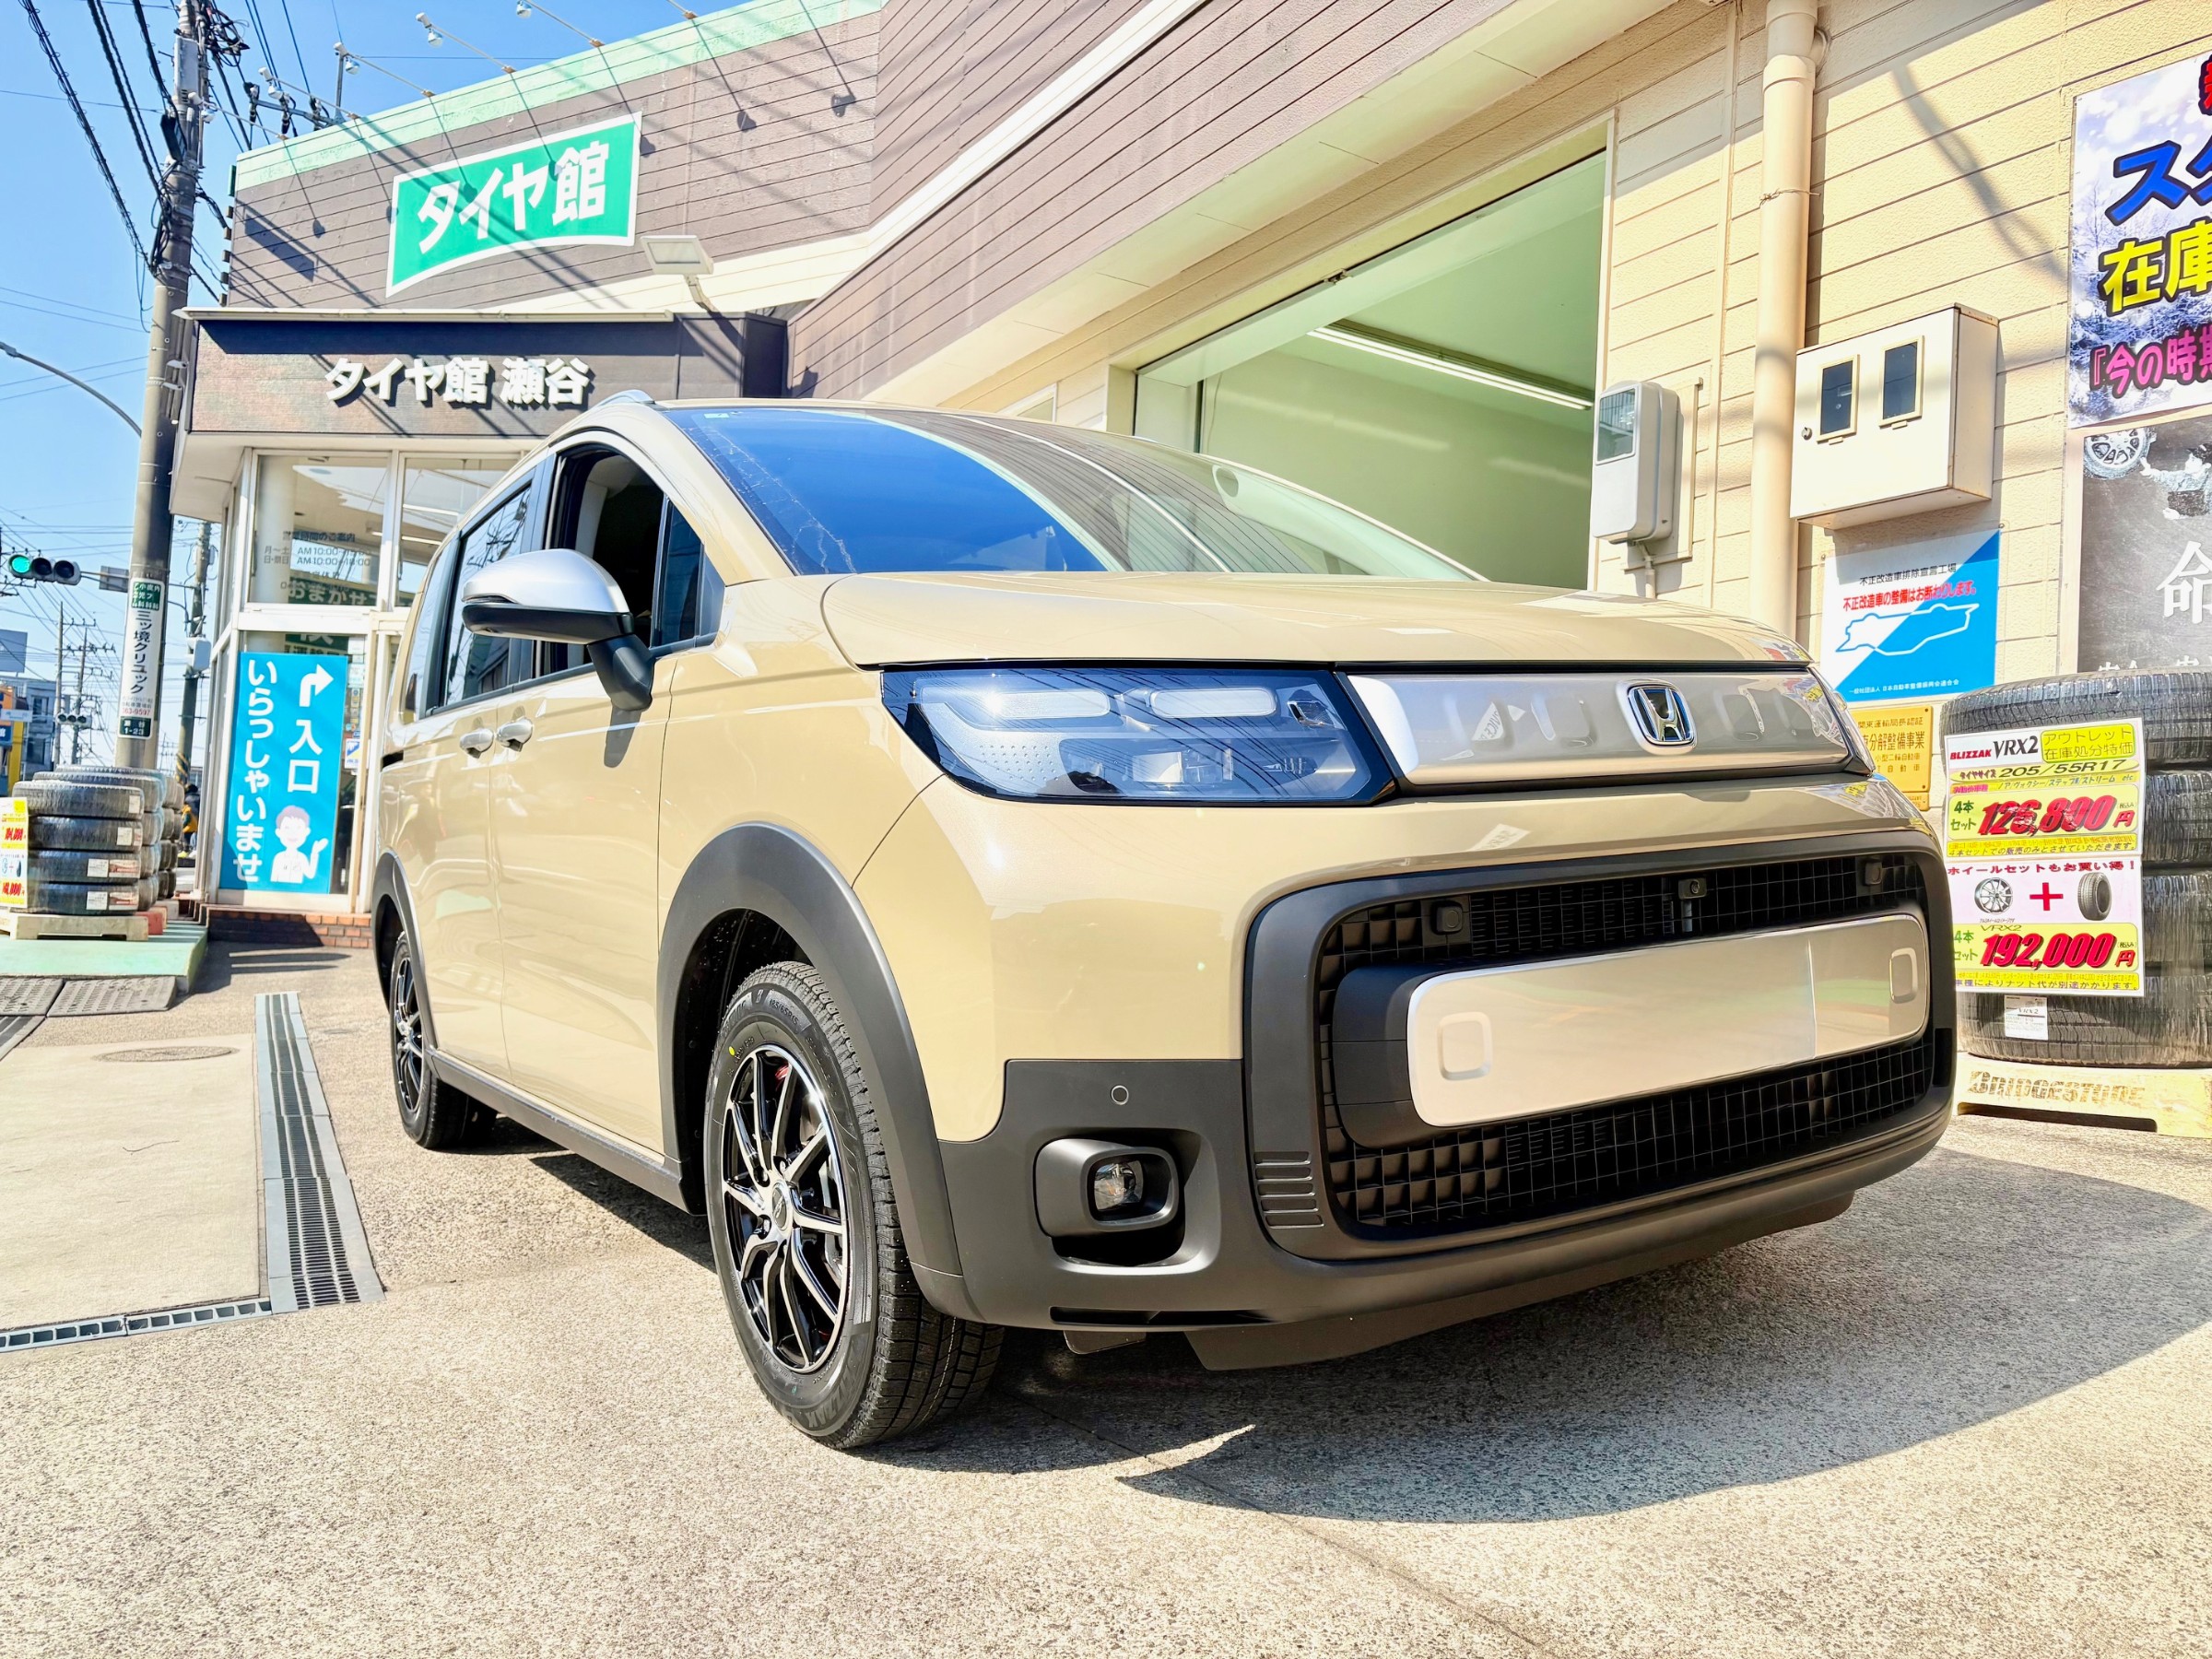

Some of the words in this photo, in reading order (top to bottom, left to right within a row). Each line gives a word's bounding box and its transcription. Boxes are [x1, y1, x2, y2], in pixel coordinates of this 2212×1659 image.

[417, 140, 609, 254] タイヤ館
[324, 357, 489, 405] タイヤ館
[500, 357, 590, 405] 瀬谷
[1859, 562, 1957, 586] 不正改造車排除宣言工場
[2156, 540, 2212, 625] 命
[1842, 581, 1977, 611] 不正改造車の整備はお断わりします。
[1949, 748, 1992, 760] BLIZZAK
[1993, 735, 2039, 759] VRX2
[2042, 727, 2133, 746] アウトレット
[288, 719, 323, 794] 入口
[2043, 742, 2134, 760] 在庫処分特価
[232, 659, 277, 883] いらっしゃいませ
[1959, 769, 1997, 781] タイヤサイズ
[1998, 759, 2127, 779] 205/55R17
[1953, 800, 1974, 814] 4本
[2112, 809, 2136, 828] 円
[1950, 818, 1977, 831] セット
[1954, 930, 1974, 944] 4本
[1980, 924, 2022, 933] VRX2
[1980, 933, 2117, 971] 192,000
[2114, 949, 2136, 967] 円
